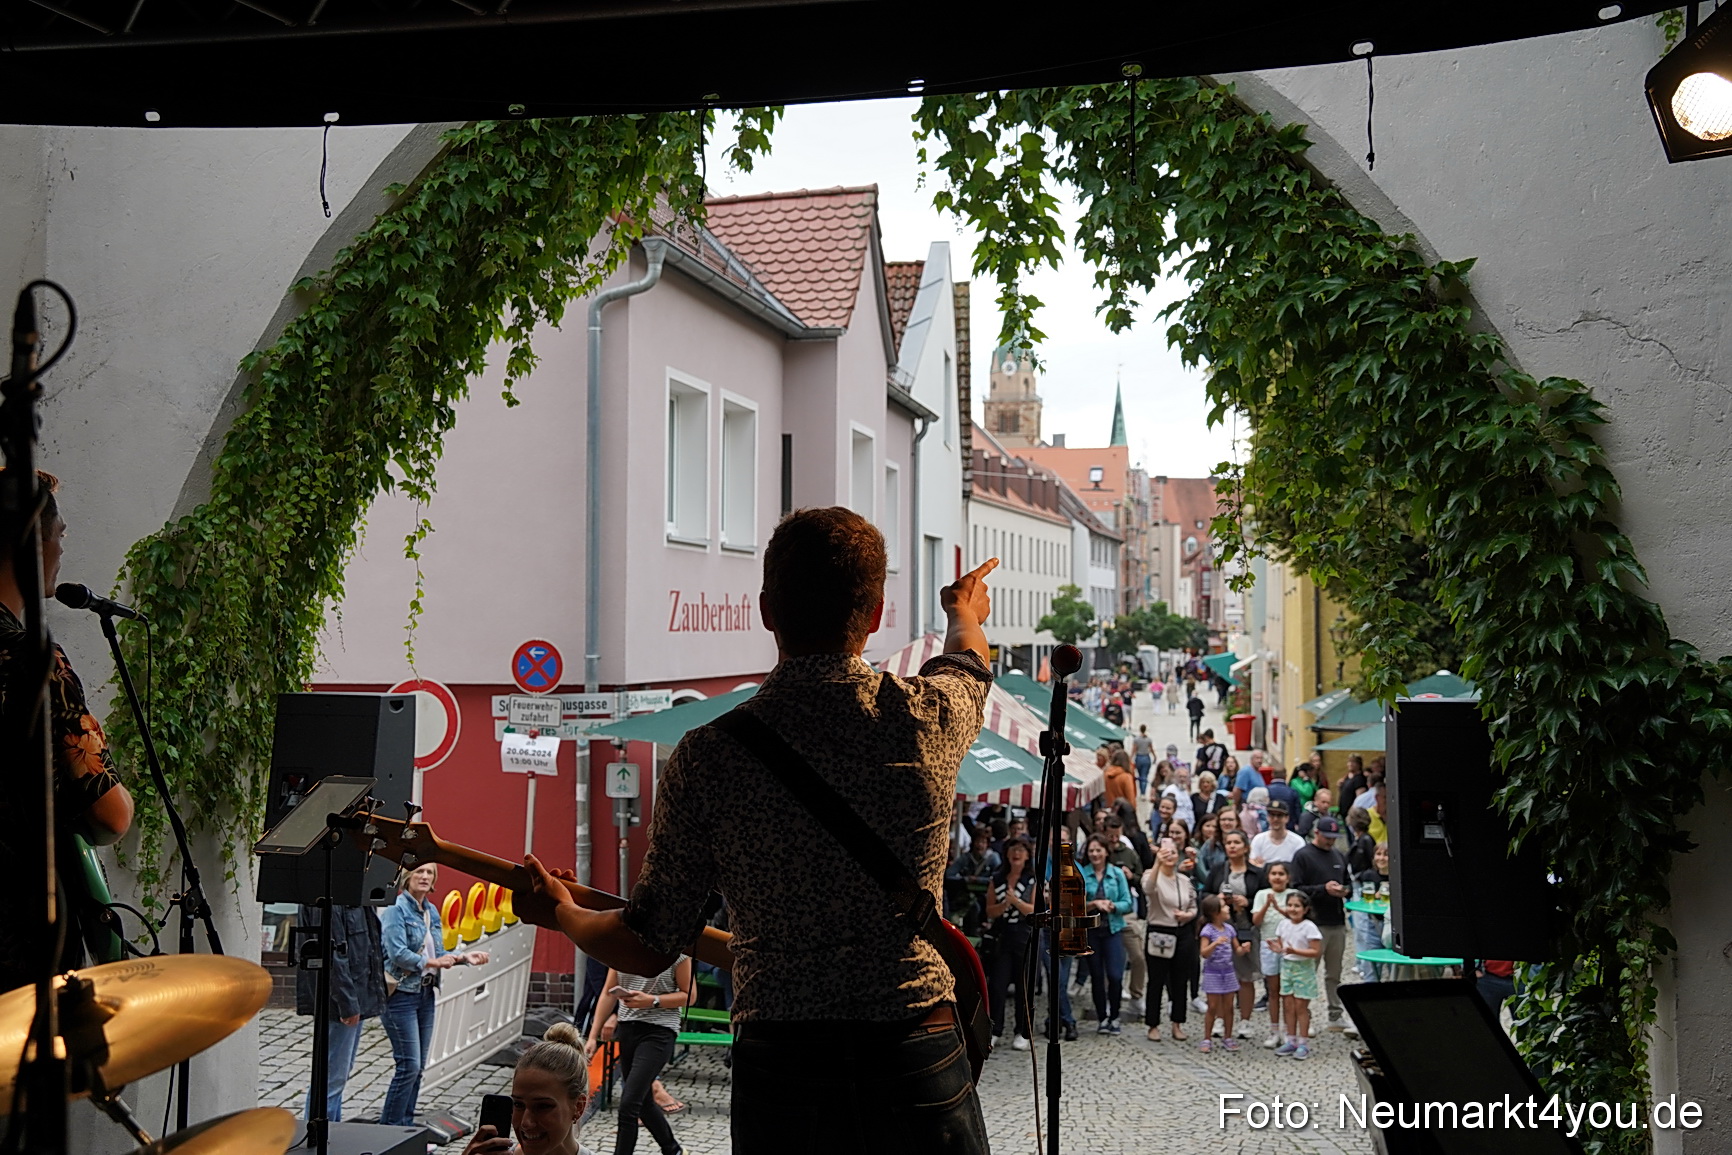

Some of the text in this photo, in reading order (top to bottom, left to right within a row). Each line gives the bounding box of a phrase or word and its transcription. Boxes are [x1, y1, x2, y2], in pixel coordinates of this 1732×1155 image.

[668, 590, 752, 632] Zauberhaft
[512, 699, 558, 711] Feuerwehr-
[520, 712, 549, 723] zufahrt
[506, 747, 552, 758] 20.06.2024
[510, 757, 549, 767] 13:00 Uhr
